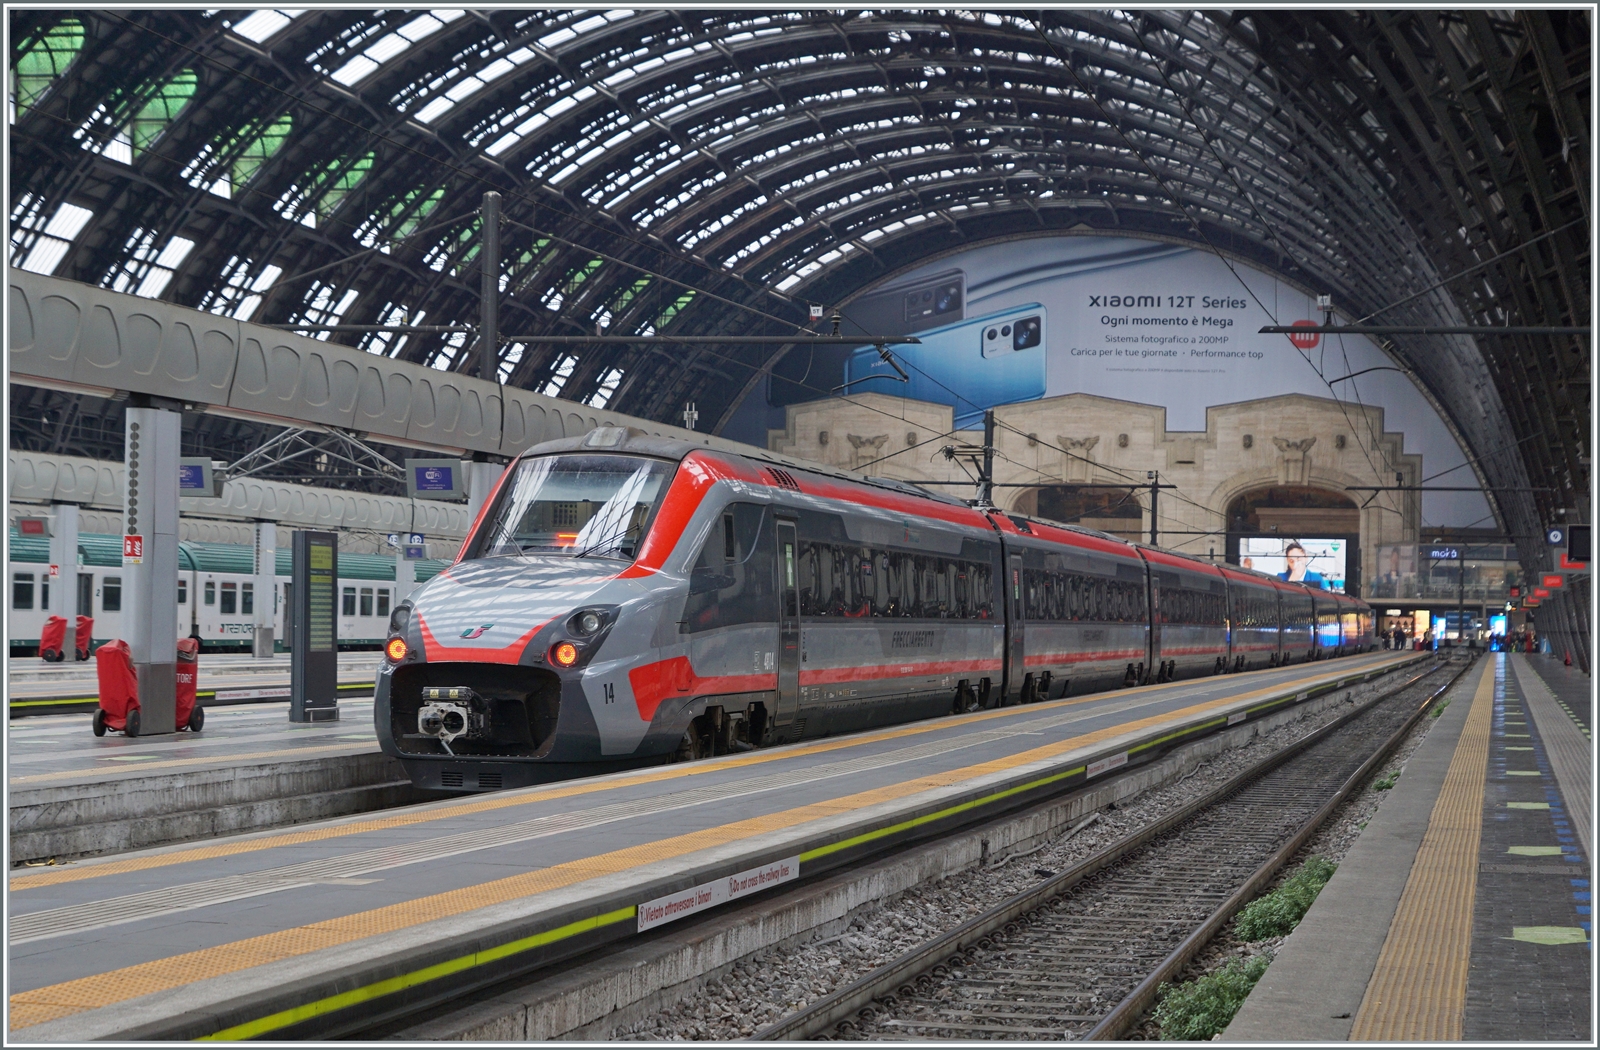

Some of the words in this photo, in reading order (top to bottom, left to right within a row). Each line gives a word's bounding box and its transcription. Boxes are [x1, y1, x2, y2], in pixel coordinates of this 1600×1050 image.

[1167, 295, 1195, 308] 12T
[1202, 296, 1247, 309] Series
[1101, 315, 1129, 328] Ogni
[1131, 315, 1188, 326] momento
[1191, 315, 1198, 326] è
[1202, 316, 1233, 329] Mega
[1105, 334, 1139, 343] Sistema
[1141, 334, 1189, 345] fotografico
[1199, 336, 1229, 344] 200MP
[1070, 347, 1097, 356] Carica
[1099, 349, 1113, 358] per
[1115, 348, 1123, 356] le
[1125, 349, 1139, 357] tue
[1141, 349, 1178, 358] giornate
[1190, 349, 1246, 358] Performance
[1248, 351, 1263, 360] top
[603, 682, 615, 705] 14
[733, 879, 740, 893] Do
[740, 877, 748, 891] not
[748, 876, 758, 888] cross
[766, 867, 780, 882] railway
[780, 863, 790, 878] lines
[645, 905, 664, 922] Vietato
[665, 896, 695, 916] attraversare
[698, 887, 712, 905] binari
